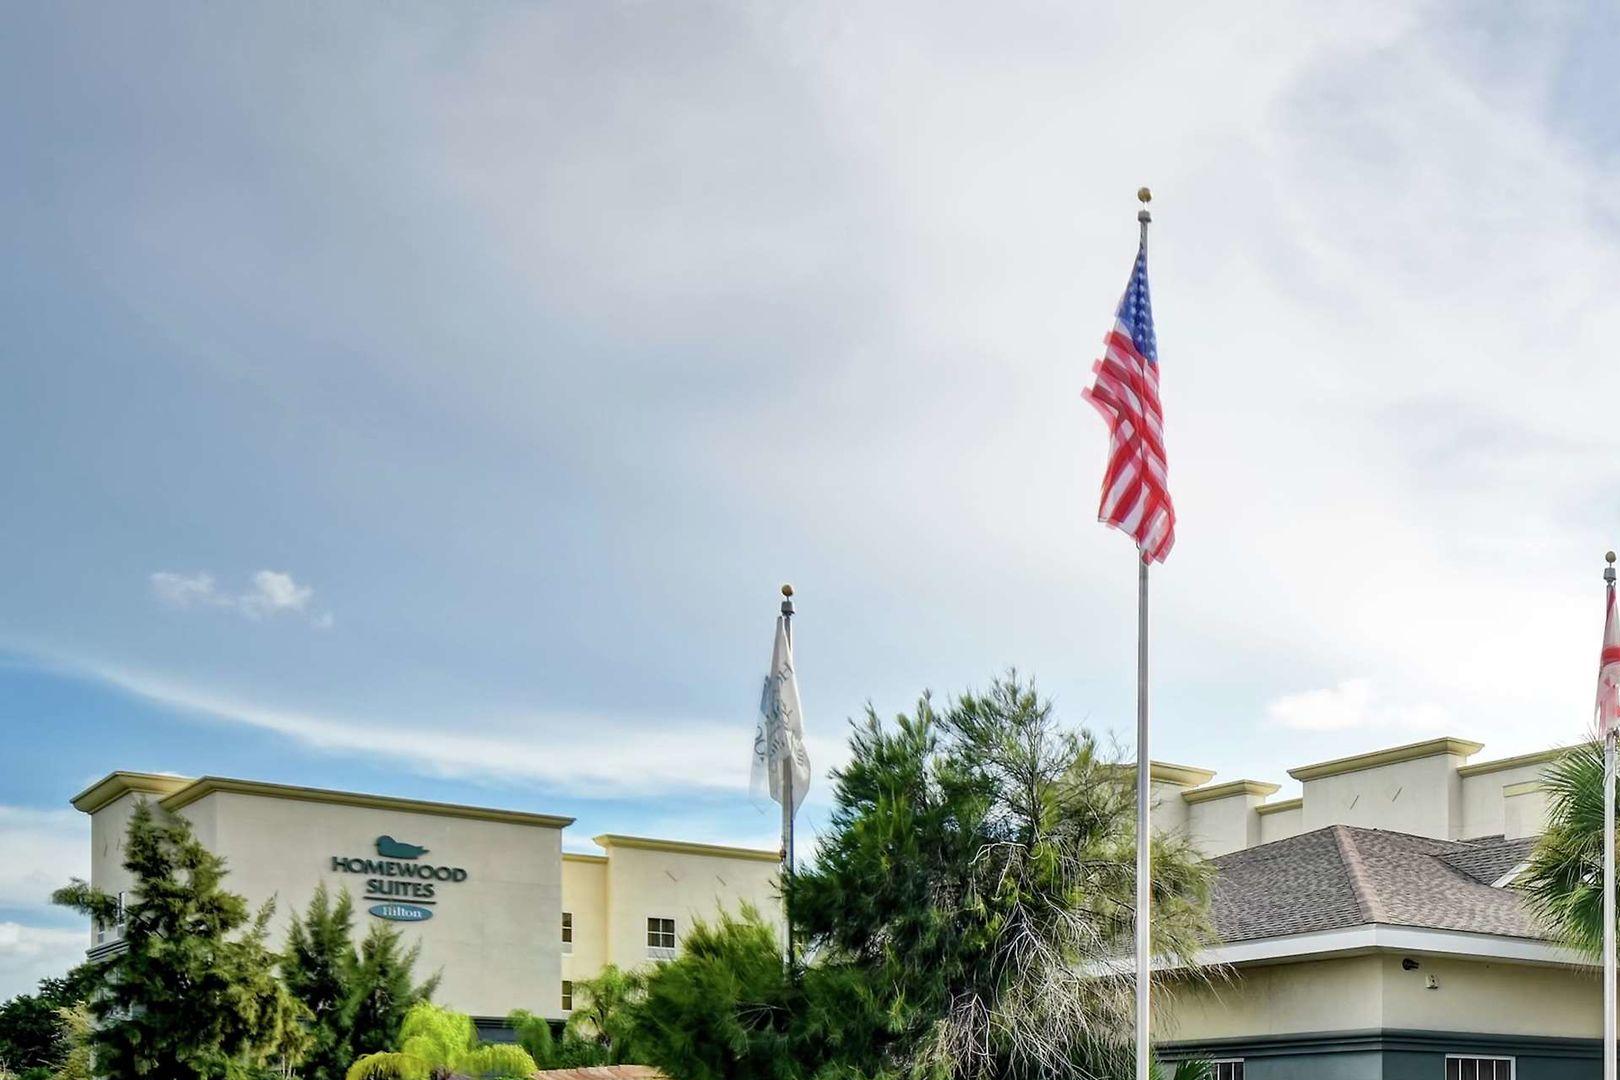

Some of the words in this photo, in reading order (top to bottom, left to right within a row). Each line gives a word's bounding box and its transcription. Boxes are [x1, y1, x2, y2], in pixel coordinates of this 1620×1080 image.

[331, 856, 468, 882] HOMEWOOD
[366, 879, 435, 898] SUITES
[383, 906, 422, 918] Hilton
